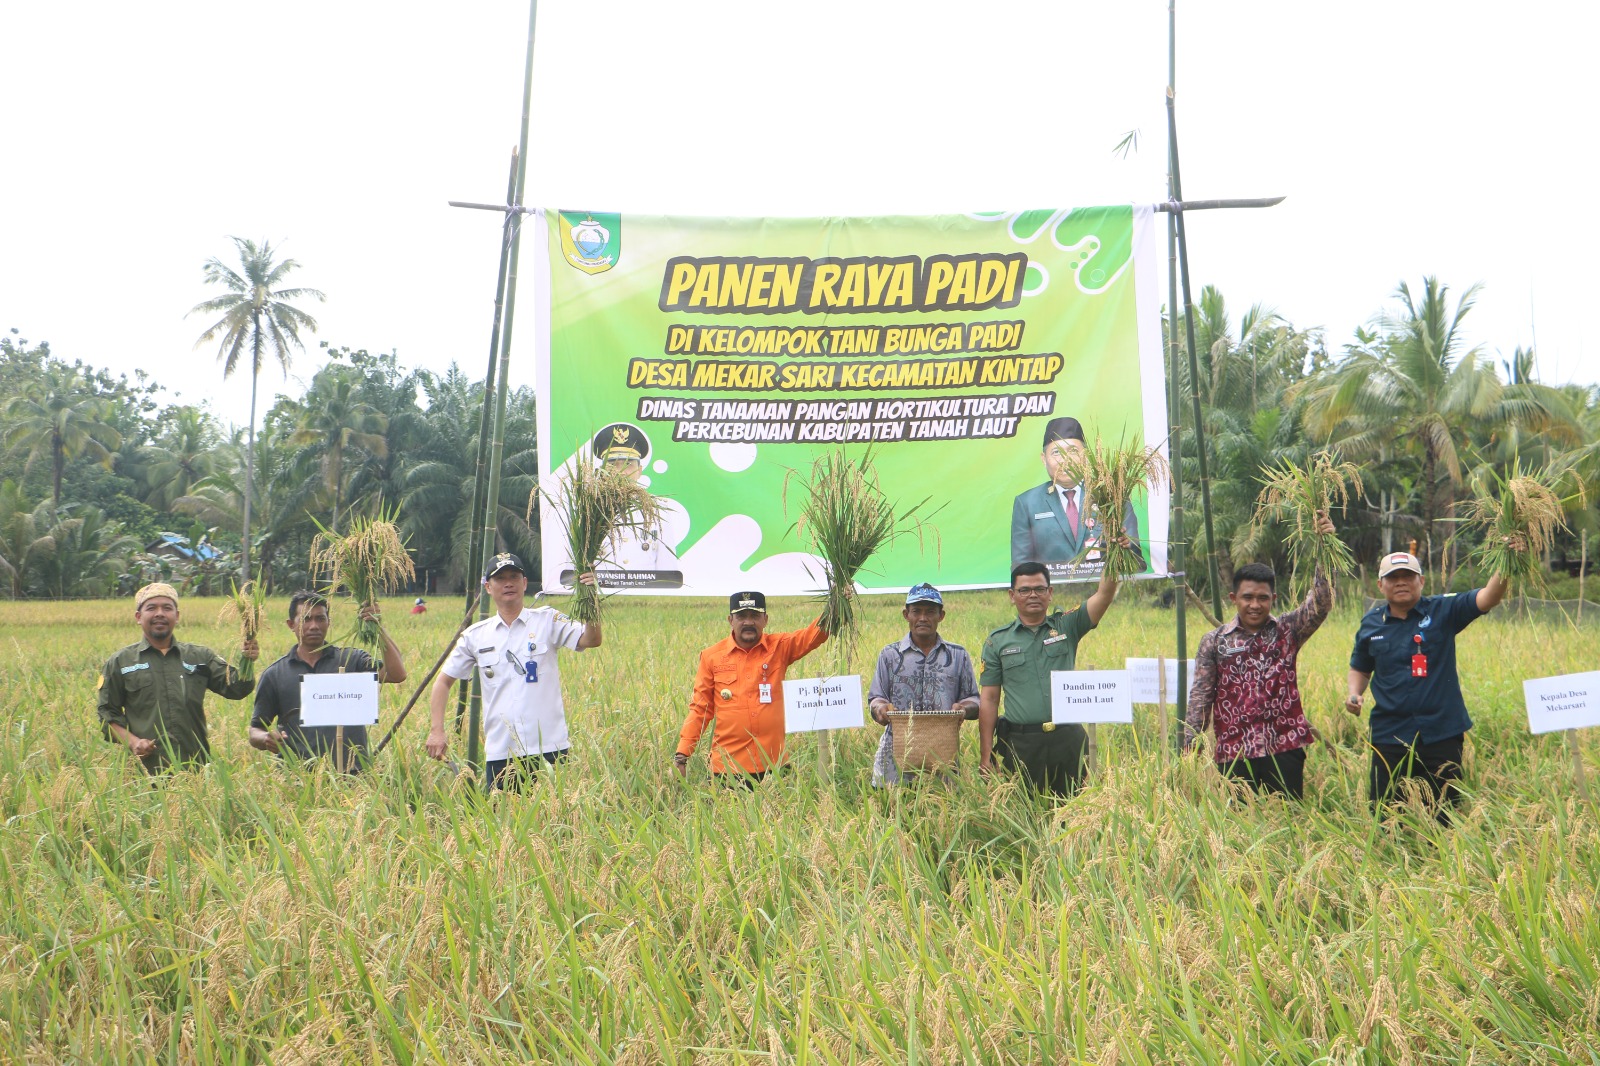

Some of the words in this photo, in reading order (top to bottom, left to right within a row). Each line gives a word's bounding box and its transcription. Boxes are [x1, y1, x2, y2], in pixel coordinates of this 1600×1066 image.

[666, 262, 804, 308] PANEN
[809, 262, 915, 309] RAYA
[924, 259, 1021, 306] PADI
[668, 327, 695, 352] DI
[698, 328, 826, 355] KELOMPOK
[829, 328, 880, 355] TANI
[883, 326, 963, 354] BUNGA
[968, 323, 1022, 350] PADI
[630, 360, 688, 387] DESA
[691, 363, 777, 389] MEKAR
[780, 364, 836, 390] SARI
[840, 359, 978, 388] KECAMATAN
[979, 356, 1061, 384] KINTAP
[640, 400, 697, 419] DINAS
[700, 401, 792, 421] TANAMAN
[794, 401, 873, 421] PANGAN
[874, 397, 1009, 420] HORTIKULTURA
[1012, 394, 1053, 415] DAN
[676, 421, 796, 441] PERKEBUNAN
[797, 421, 905, 441] KABUPATEN
[908, 418, 970, 439] TANAH
[971, 416, 1018, 436] LAUT
[798, 687, 811, 696] Pj.
[1063, 683, 1095, 691] Dandim
[1098, 682, 1117, 690] 1009
[338, 692, 363, 700] Kintap
[1066, 696, 1092, 704] Tanah
[1094, 696, 1114, 704] Laut
[1540, 692, 1568, 702] Kepala
[1569, 690, 1588, 698] Desa
[796, 699, 823, 709] Tanah
[826, 698, 847, 707] Laut
[1546, 701, 1586, 712] Mekarsari
